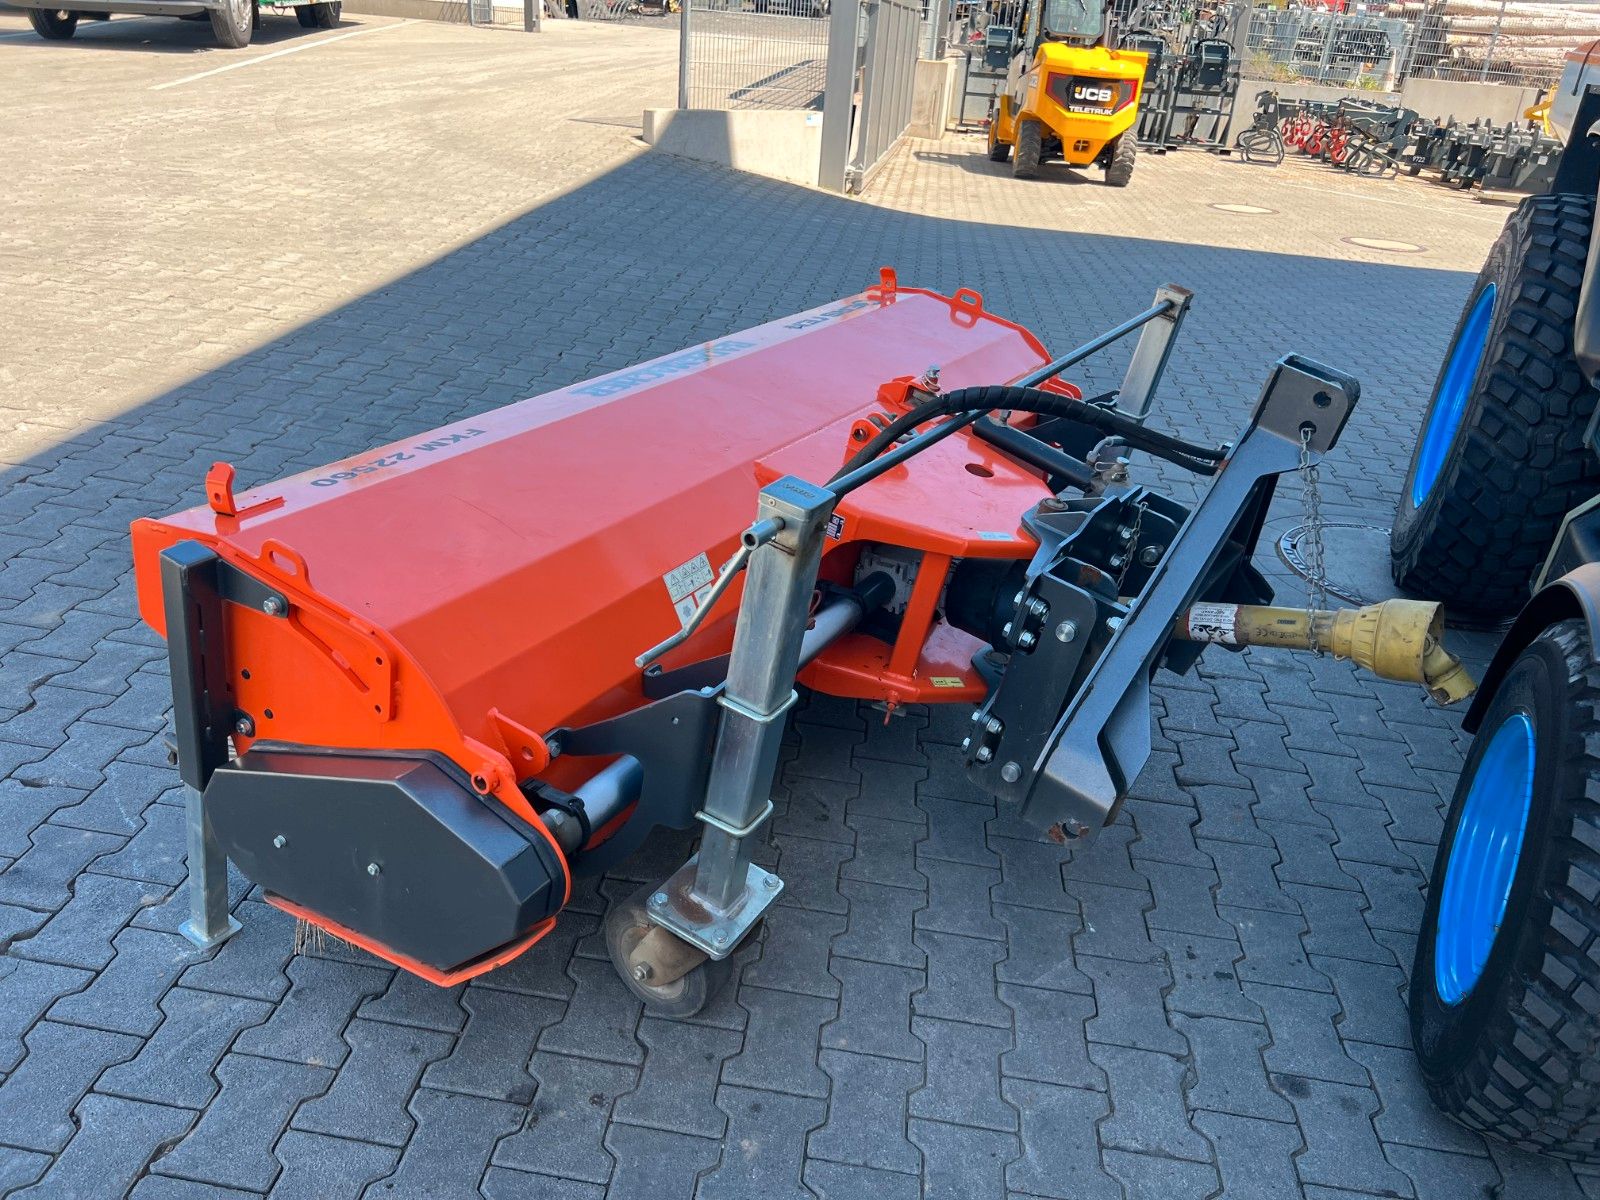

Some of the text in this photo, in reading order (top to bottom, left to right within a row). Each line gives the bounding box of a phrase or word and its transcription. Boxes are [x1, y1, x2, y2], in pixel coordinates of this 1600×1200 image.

[1074, 86, 1112, 102] JCB
[1068, 105, 1114, 116] TELETRUK
[310, 428, 487, 487] FKM 22560
